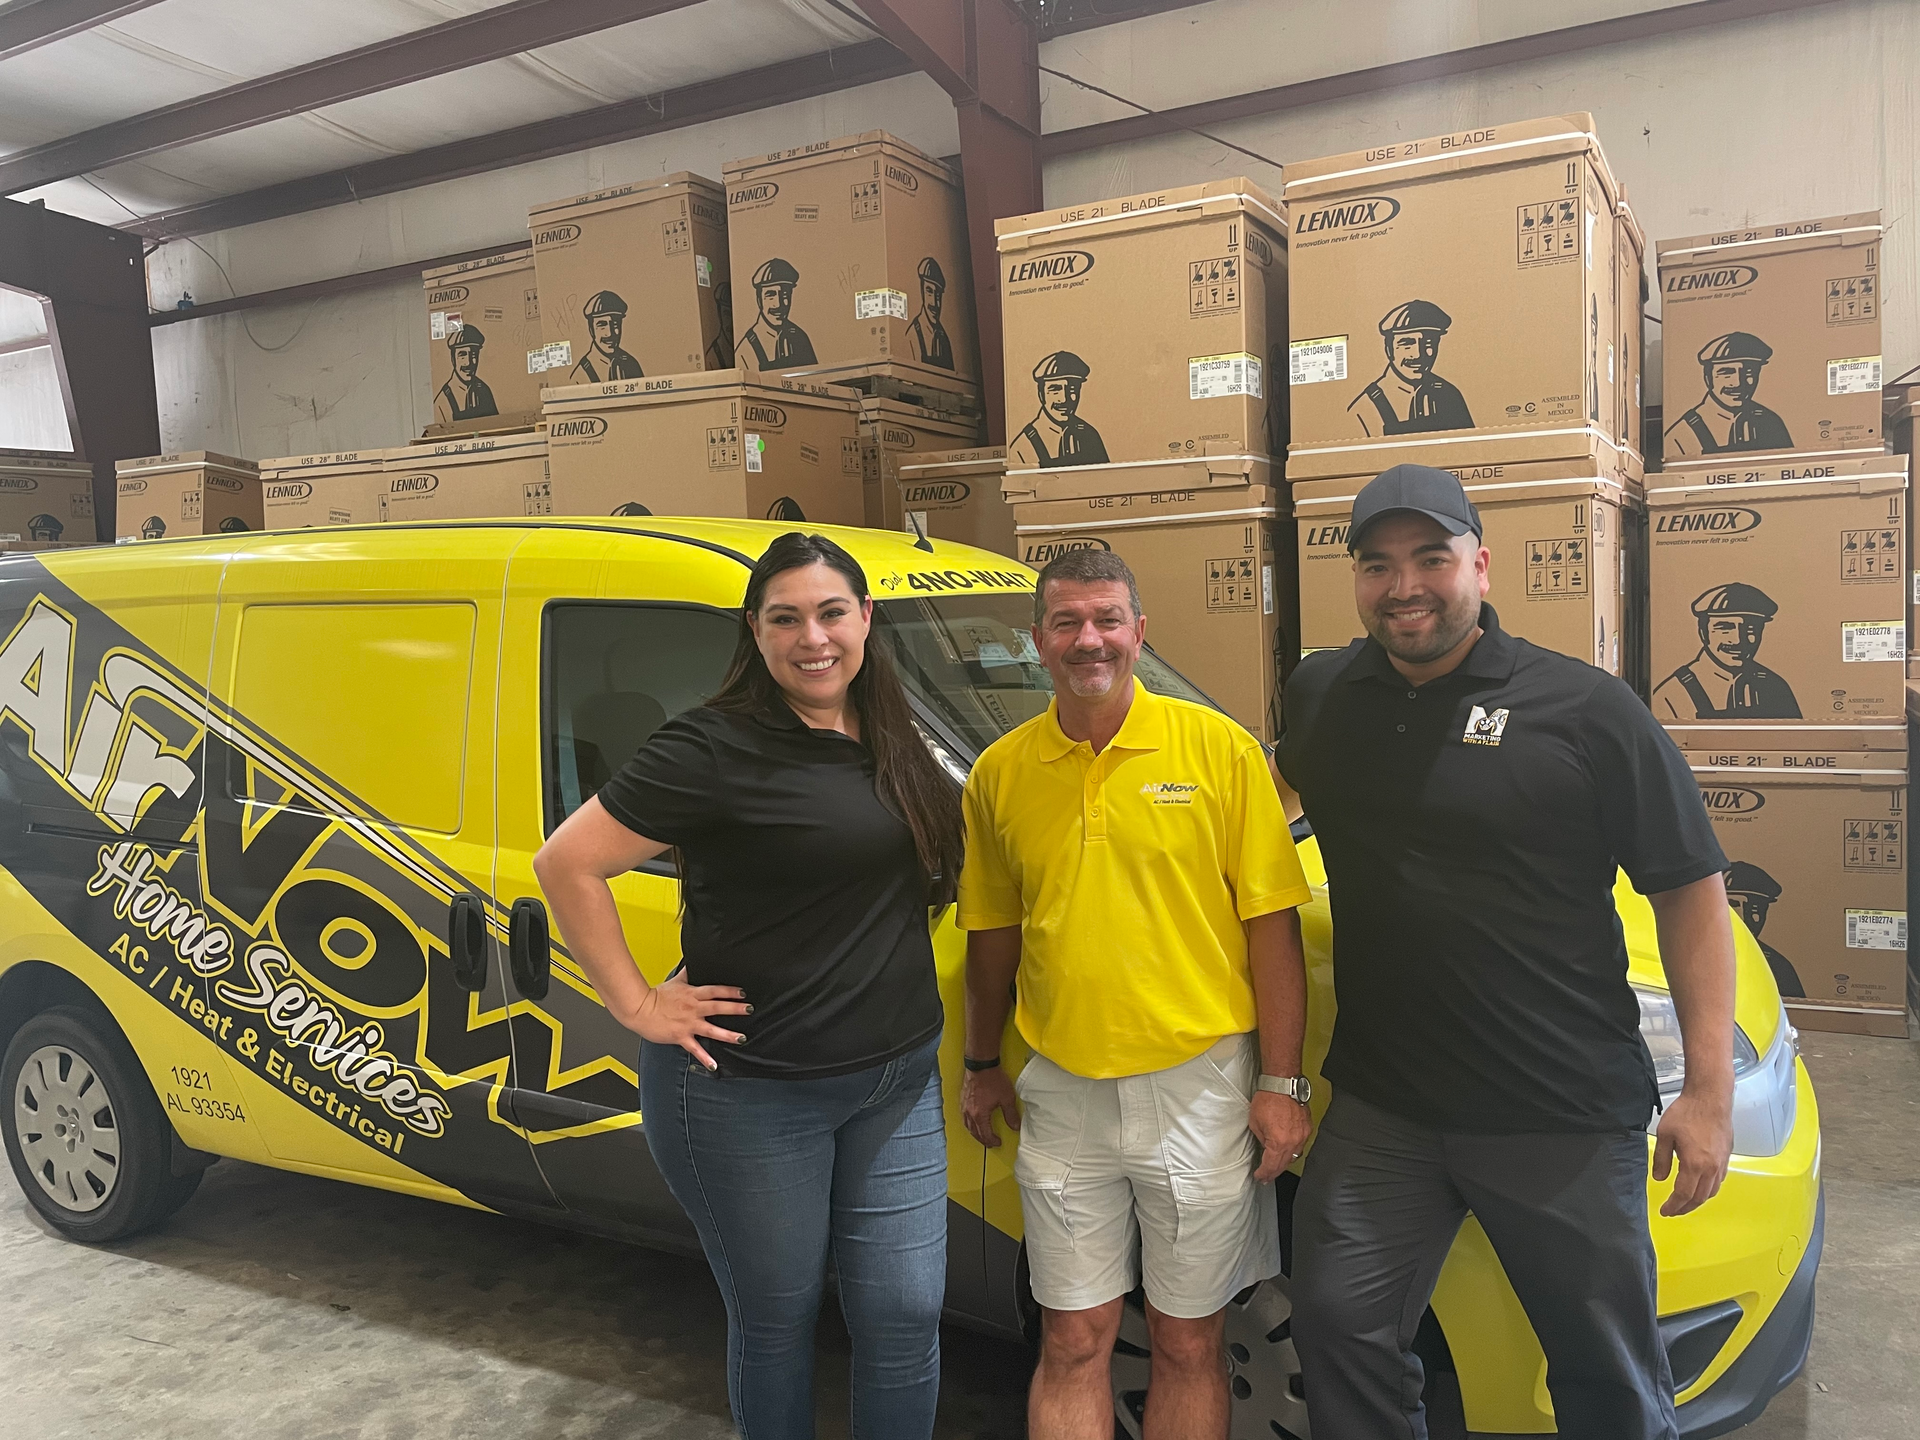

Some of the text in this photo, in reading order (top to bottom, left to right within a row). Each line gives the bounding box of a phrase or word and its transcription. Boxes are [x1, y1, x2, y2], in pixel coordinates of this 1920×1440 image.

[767, 152, 782, 162] USE
[805, 141, 830, 154] BLADE
[1365, 147, 1396, 162] USE
[1440, 129, 1496, 150] BLADE
[884, 164, 912, 188] LENNOX
[610, 185, 633, 197] BLADE
[729, 185, 770, 205] LENNOX
[1060, 209, 1085, 223] USE
[1121, 195, 1166, 213] BLADE
[1295, 201, 1380, 234] LENNOX
[534, 227, 572, 245] LENNOX
[1295, 238, 1330, 249] Innovation
[1330, 235, 1348, 244] never
[1349, 232, 1360, 240] felt
[1711, 234, 1738, 246] USE
[1775, 223, 1822, 238] BLADE
[486, 255, 506, 265] BLADE
[1008, 255, 1077, 283] LENNOX
[1666, 269, 1740, 292] LENNOX
[428, 289, 462, 305] LENNOX
[1009, 287, 1037, 297] Innovation
[1038, 285, 1052, 293] never
[1053, 282, 1061, 290] felt
[602, 385, 618, 395] USE
[645, 379, 673, 391] BLADE
[781, 379, 793, 390] USE
[811, 384, 829, 395] BLADE
[1541, 394, 1580, 403] ASSEMBLED
[744, 405, 778, 424] LENNOX
[1547, 408, 1574, 416] MEXICO
[550, 420, 596, 437] LENNOX
[883, 429, 909, 445] LENNOX
[434, 445, 448, 454] USE
[472, 440, 496, 450] BLADE
[160, 455, 180, 463] BLADE
[301, 457, 314, 466] USE
[336, 453, 358, 462] BLADE
[947, 453, 966, 462] USE
[1450, 466, 1504, 480] BLADE
[1706, 474, 1737, 486] USE
[1780, 466, 1836, 480] BLADE
[0, 478, 30, 488] ENNOX
[119, 481, 143, 493] LENNOX
[206, 475, 237, 489] LENNOX
[390, 477, 430, 493] LENNOX
[266, 483, 303, 499] LENNOX
[905, 485, 957, 502] LENNOX
[1088, 498, 1114, 509] USE
[1150, 491, 1196, 504] BLADE
[1655, 511, 1741, 532] LENNOX
[1306, 526, 1351, 546] LEN
[1656, 538, 1690, 546] Innovation
[880, 571, 904, 591] Dial
[1708, 755, 1739, 766] USE
[1783, 756, 1837, 767] BLADE
[1700, 791, 1745, 808] NOX
[88, 840, 452, 1137] Home Services
[108, 933, 149, 973] AC
[169, 975, 234, 1040] Heat
[236, 1027, 261, 1062] &
[265, 1048, 405, 1154] Electrical
[171, 1065, 211, 1091] 1921
[166, 1092, 246, 1123] AL 93354
